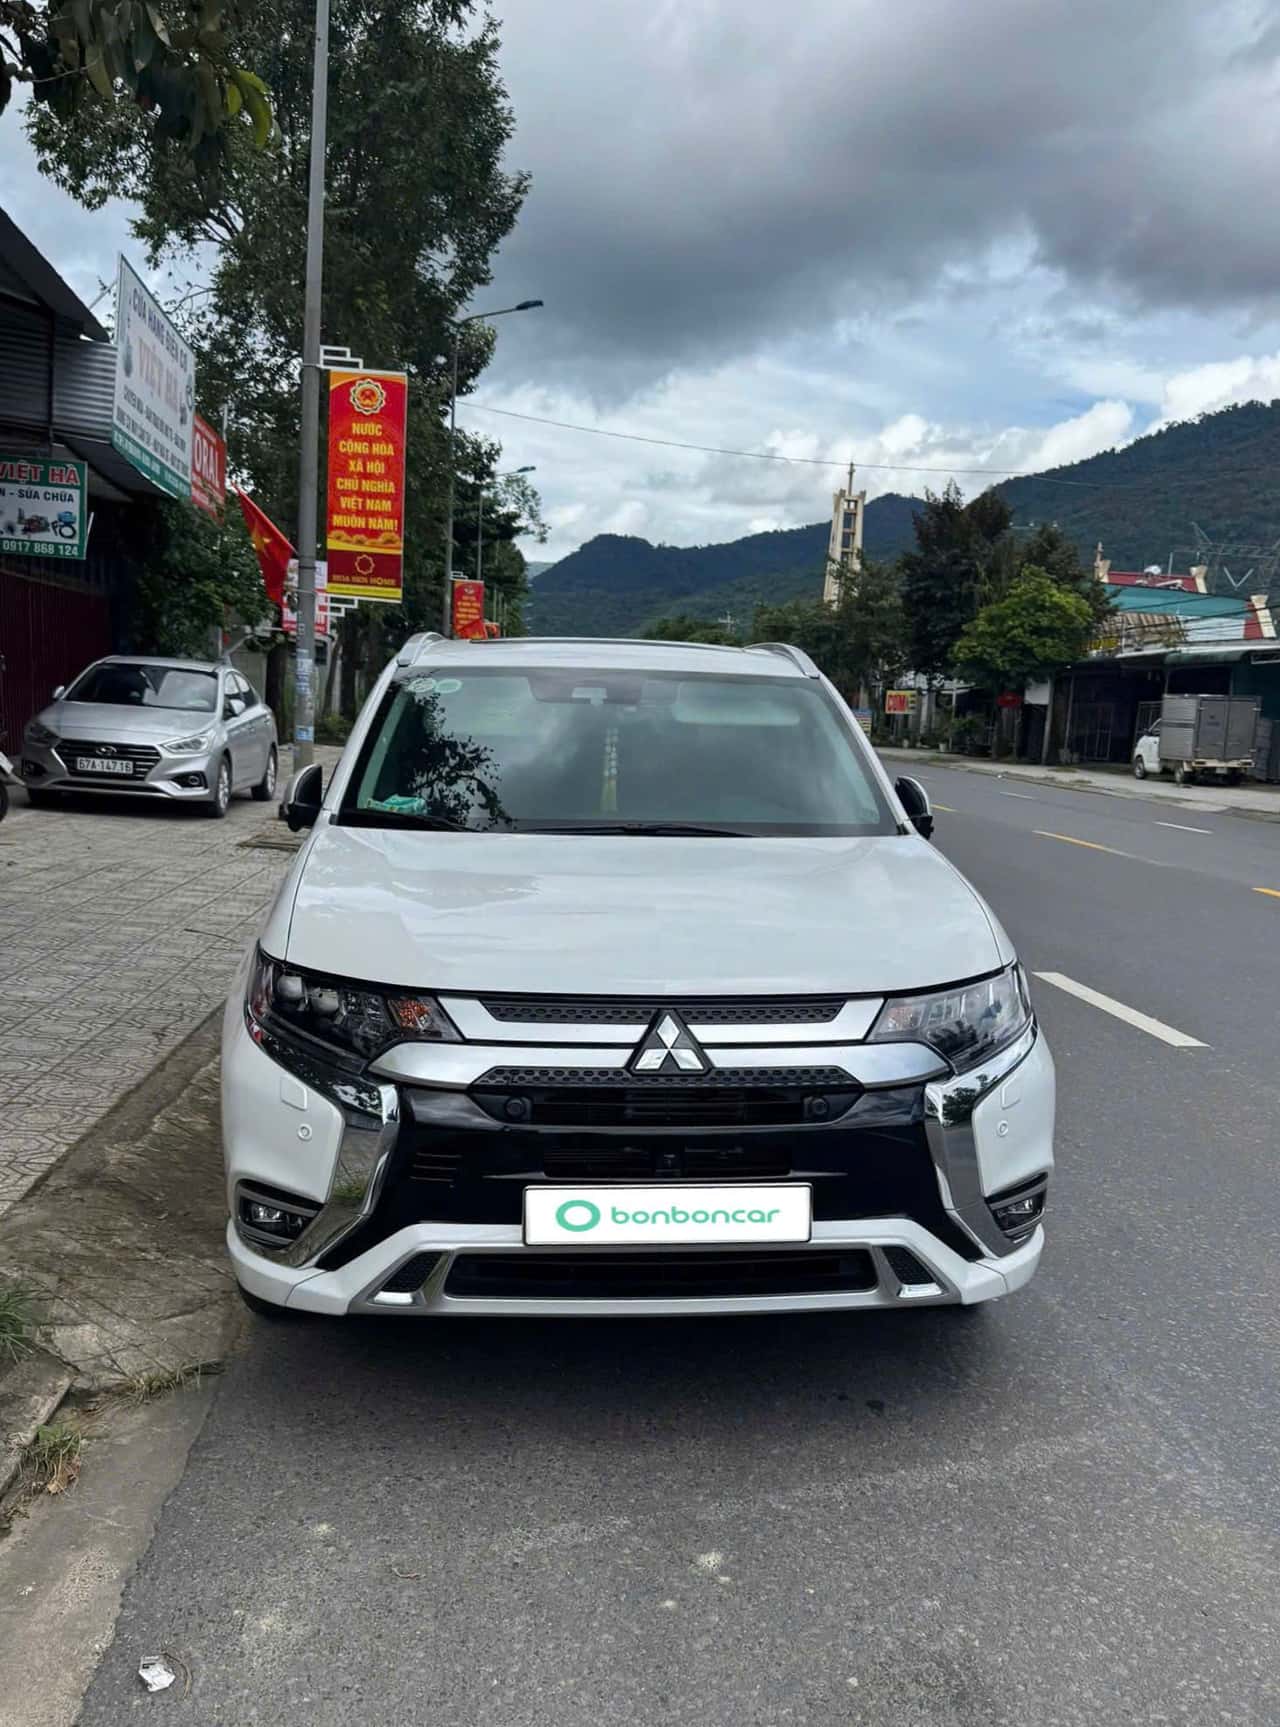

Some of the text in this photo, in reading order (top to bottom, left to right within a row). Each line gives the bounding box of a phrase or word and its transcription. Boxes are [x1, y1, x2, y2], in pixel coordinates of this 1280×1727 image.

[352, 421, 383, 436] NƯỚC
[339, 438, 369, 456] CỘNG
[0, 459, 80, 486] VIỆT HÀ
[348, 456, 385, 476] XÃ HỘI
[336, 474, 396, 494] CHỦ NGHĨA
[43, 489, 75, 503] CHỮA
[340, 493, 392, 513] VIỆT NAM
[332, 513, 366, 529] MUÔN
[2, 540, 31, 553] 0917
[58, 544, 79, 556] 124
